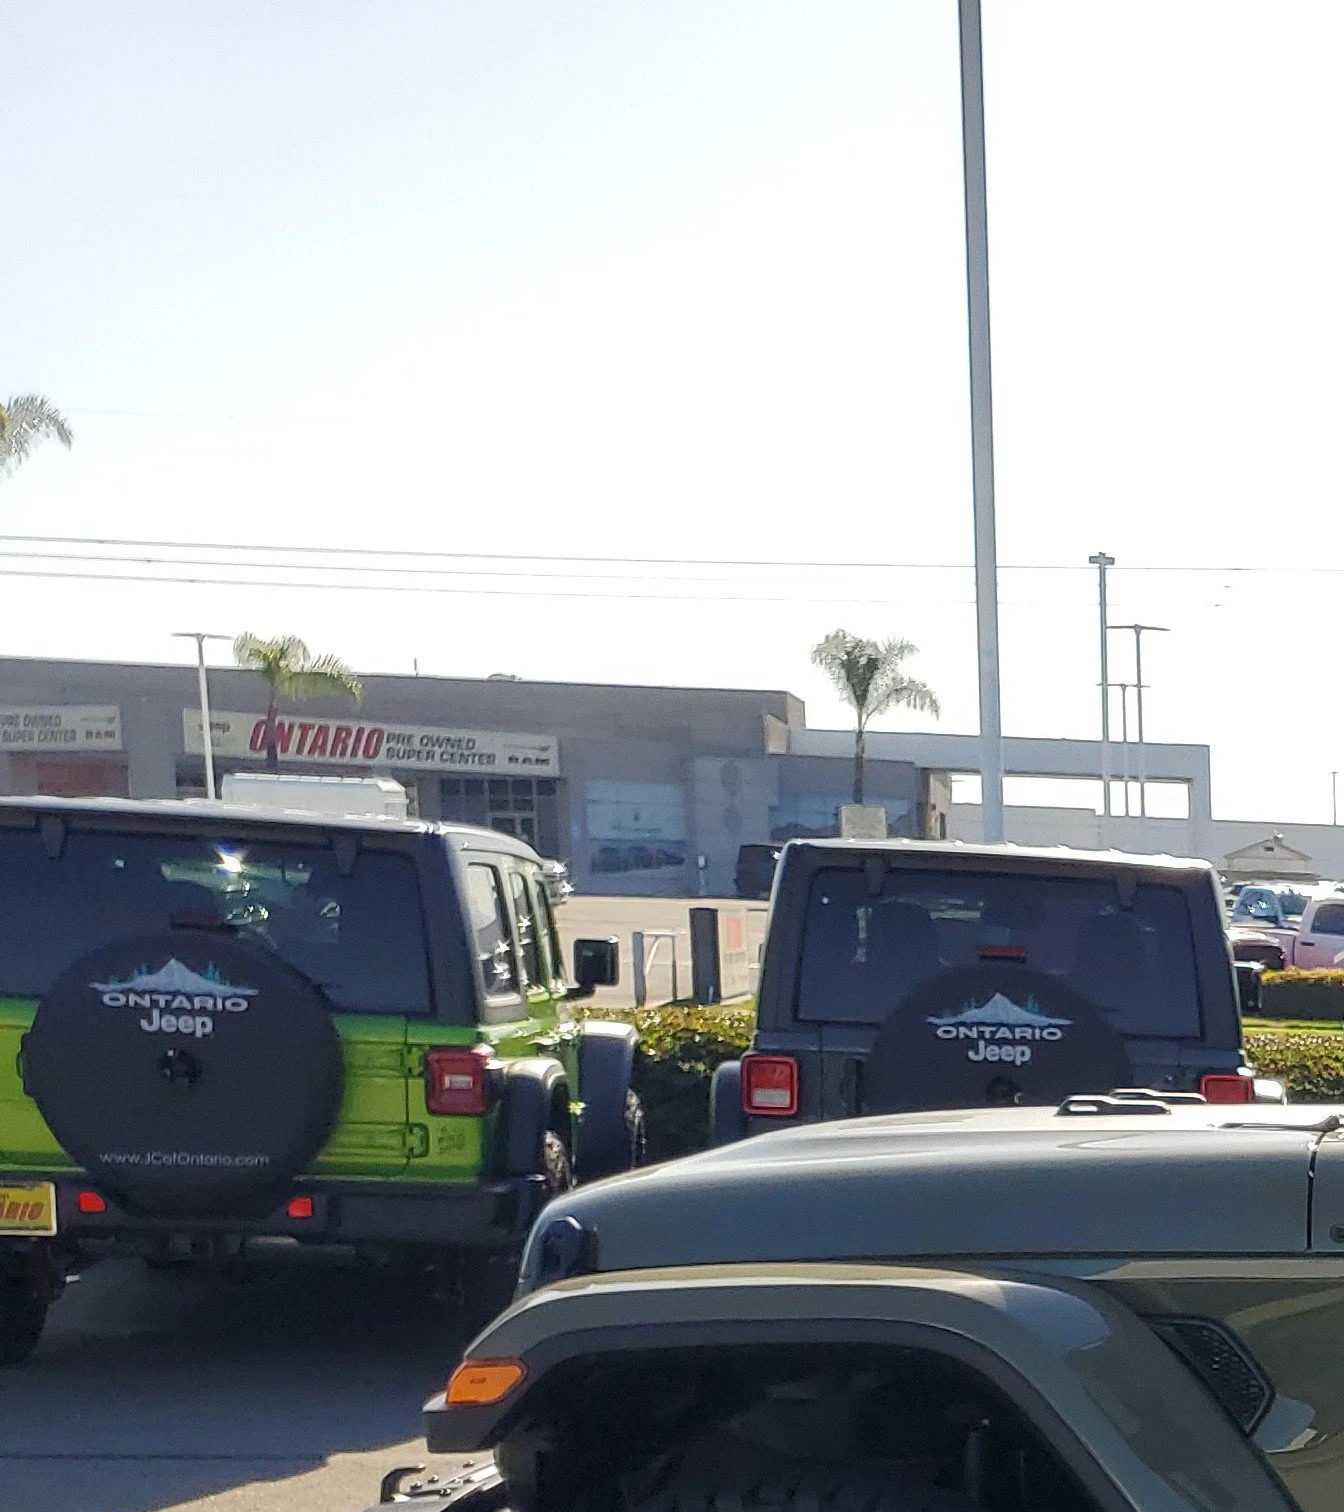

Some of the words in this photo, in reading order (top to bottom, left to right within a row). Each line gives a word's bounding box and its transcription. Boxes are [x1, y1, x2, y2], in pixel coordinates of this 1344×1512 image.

[249, 717, 385, 760] ONTARIO
[386, 732, 416, 747] PRE
[419, 734, 477, 751] OWNED
[386, 747, 435, 762] SUPER
[439, 751, 496, 766] CENTER
[102, 992, 249, 1013] ONTARIO
[140, 1008, 214, 1039] Jeep
[936, 1025, 1063, 1041] ONTARIO
[967, 1040, 1032, 1066] Jeep
